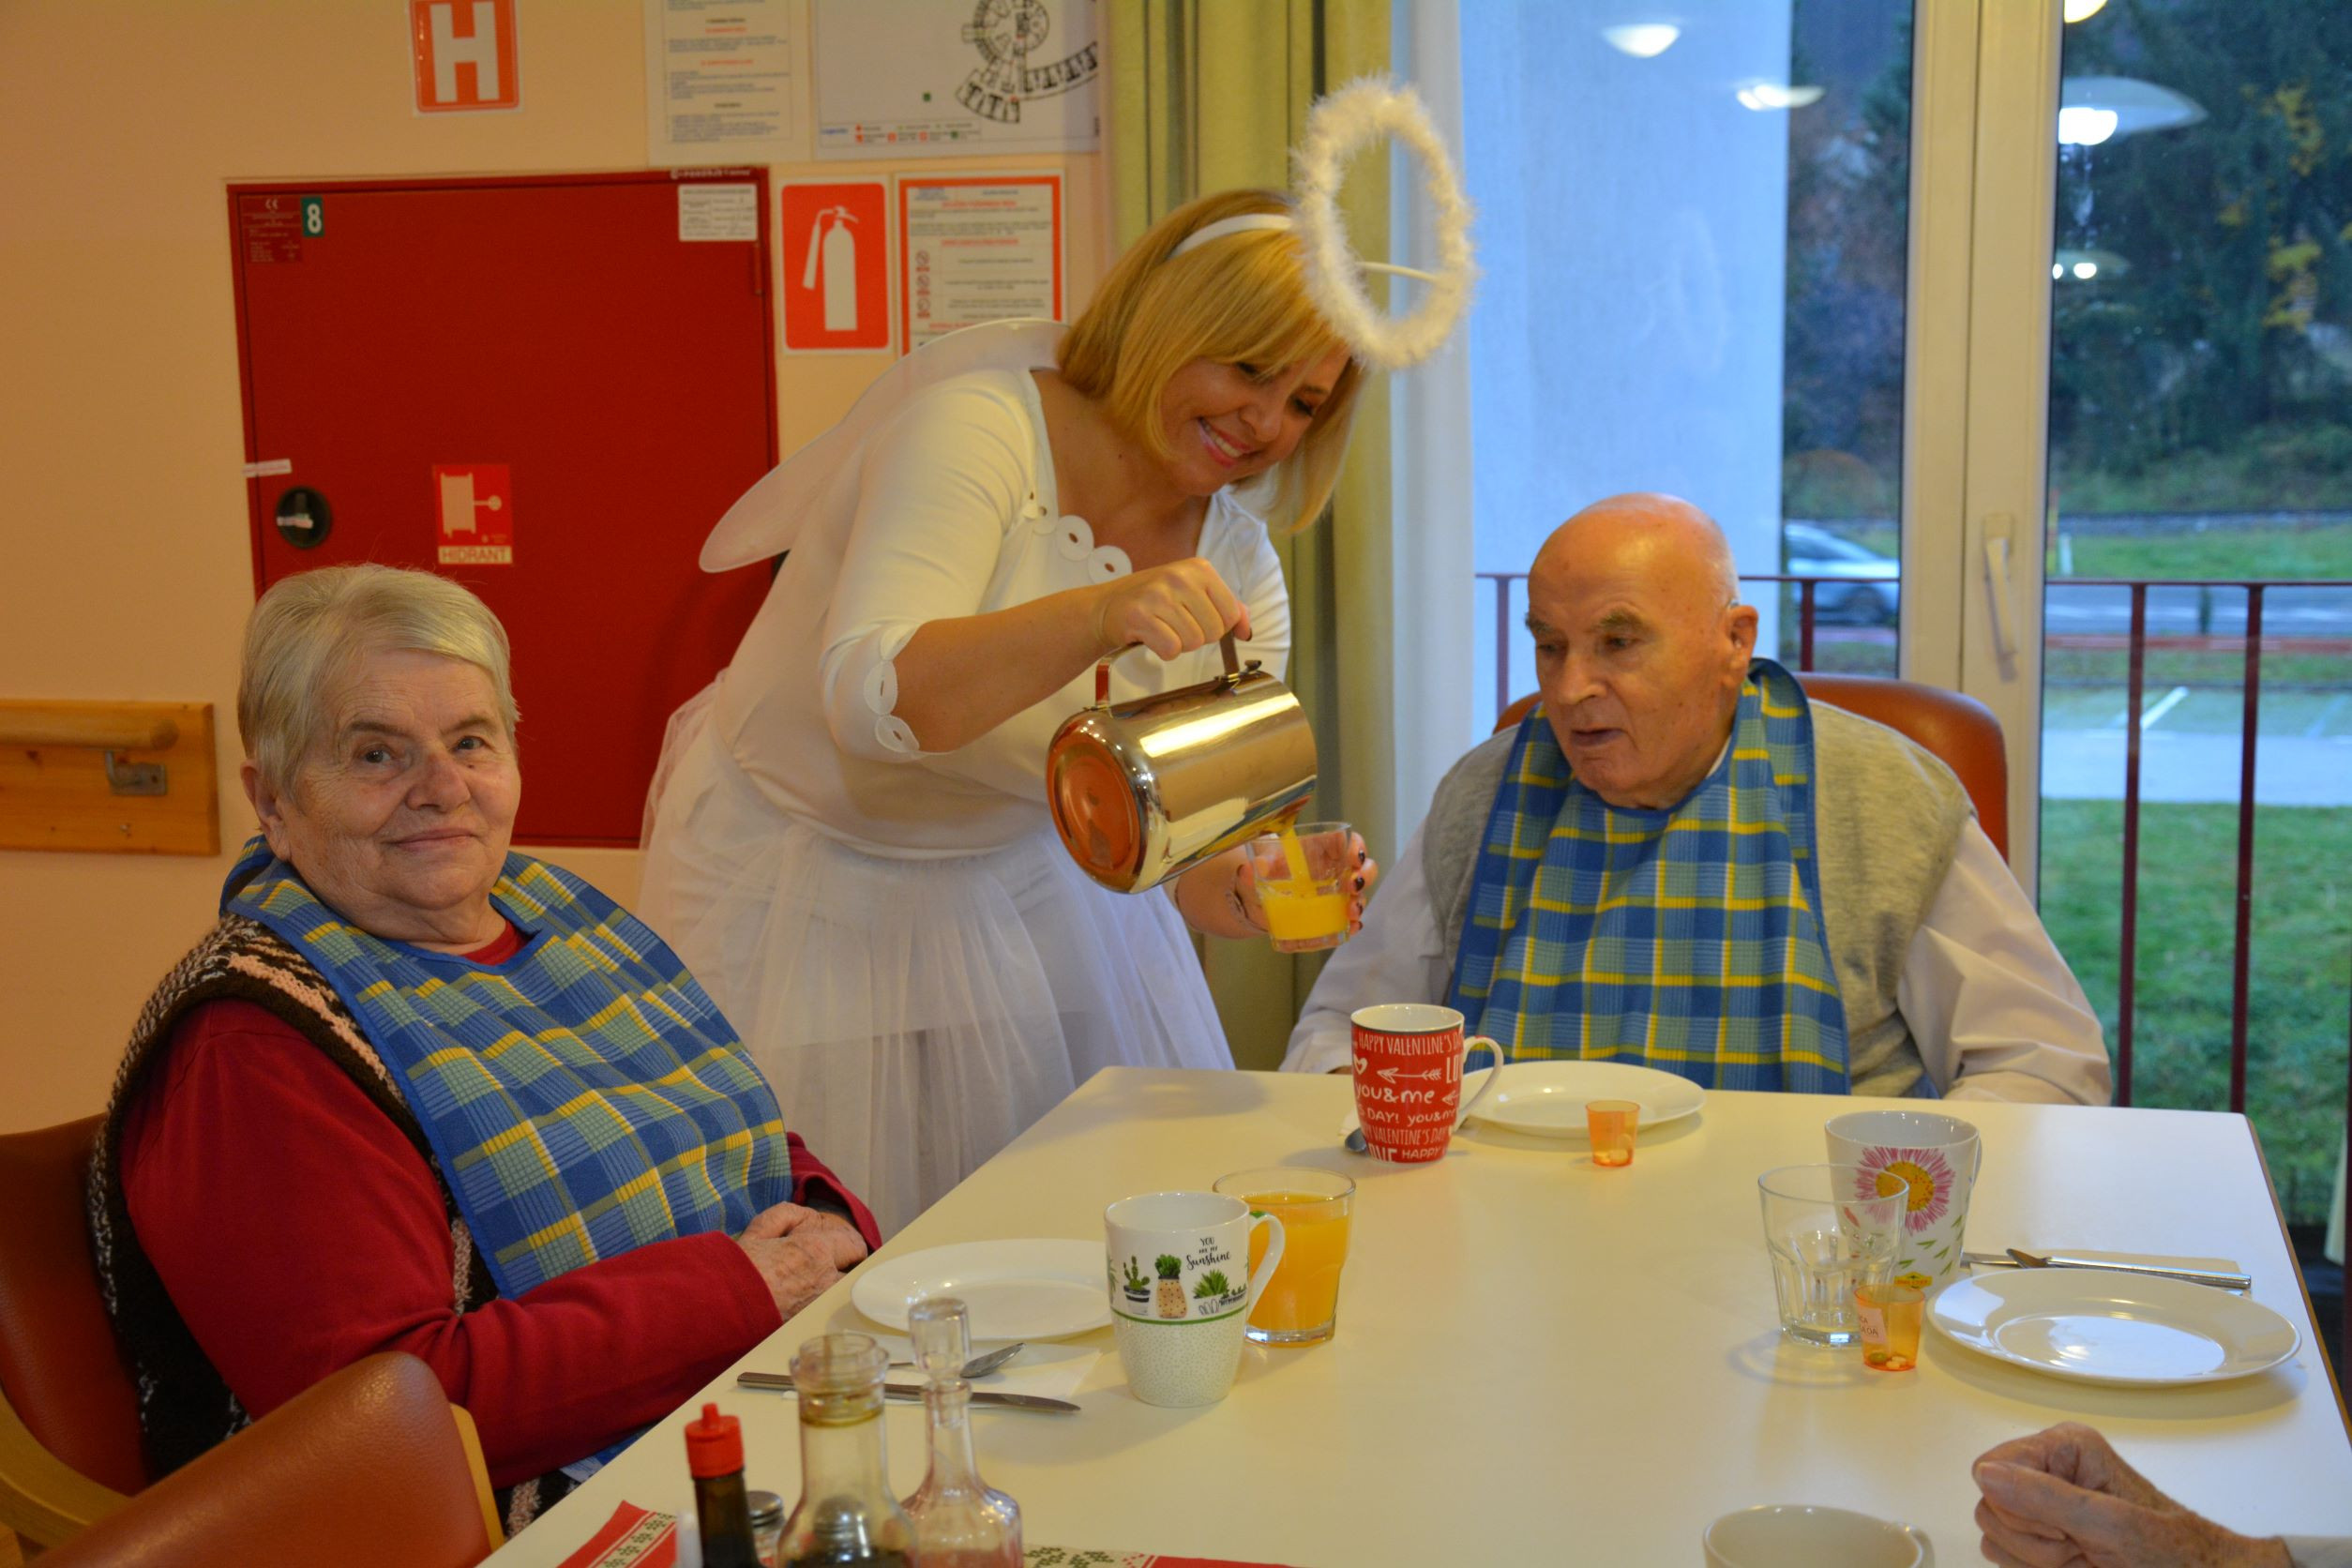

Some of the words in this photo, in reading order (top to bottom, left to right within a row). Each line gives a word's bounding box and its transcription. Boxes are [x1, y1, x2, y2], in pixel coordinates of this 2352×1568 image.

[430, 2, 500, 102] H
[308, 204, 322, 234] 8
[442, 547, 508, 563] HIDRANT
[1358, 1032, 1384, 1054] HAPPY
[1387, 1035, 1453, 1056] VALENTINE'S
[1367, 1107, 1399, 1123] DAY!
[1373, 1125, 1430, 1145] VALENTINE'S
[1402, 1146, 1440, 1159] HAPPY
[1199, 1237, 1214, 1245] YOU
[1186, 1252, 1230, 1270] Sunshine
